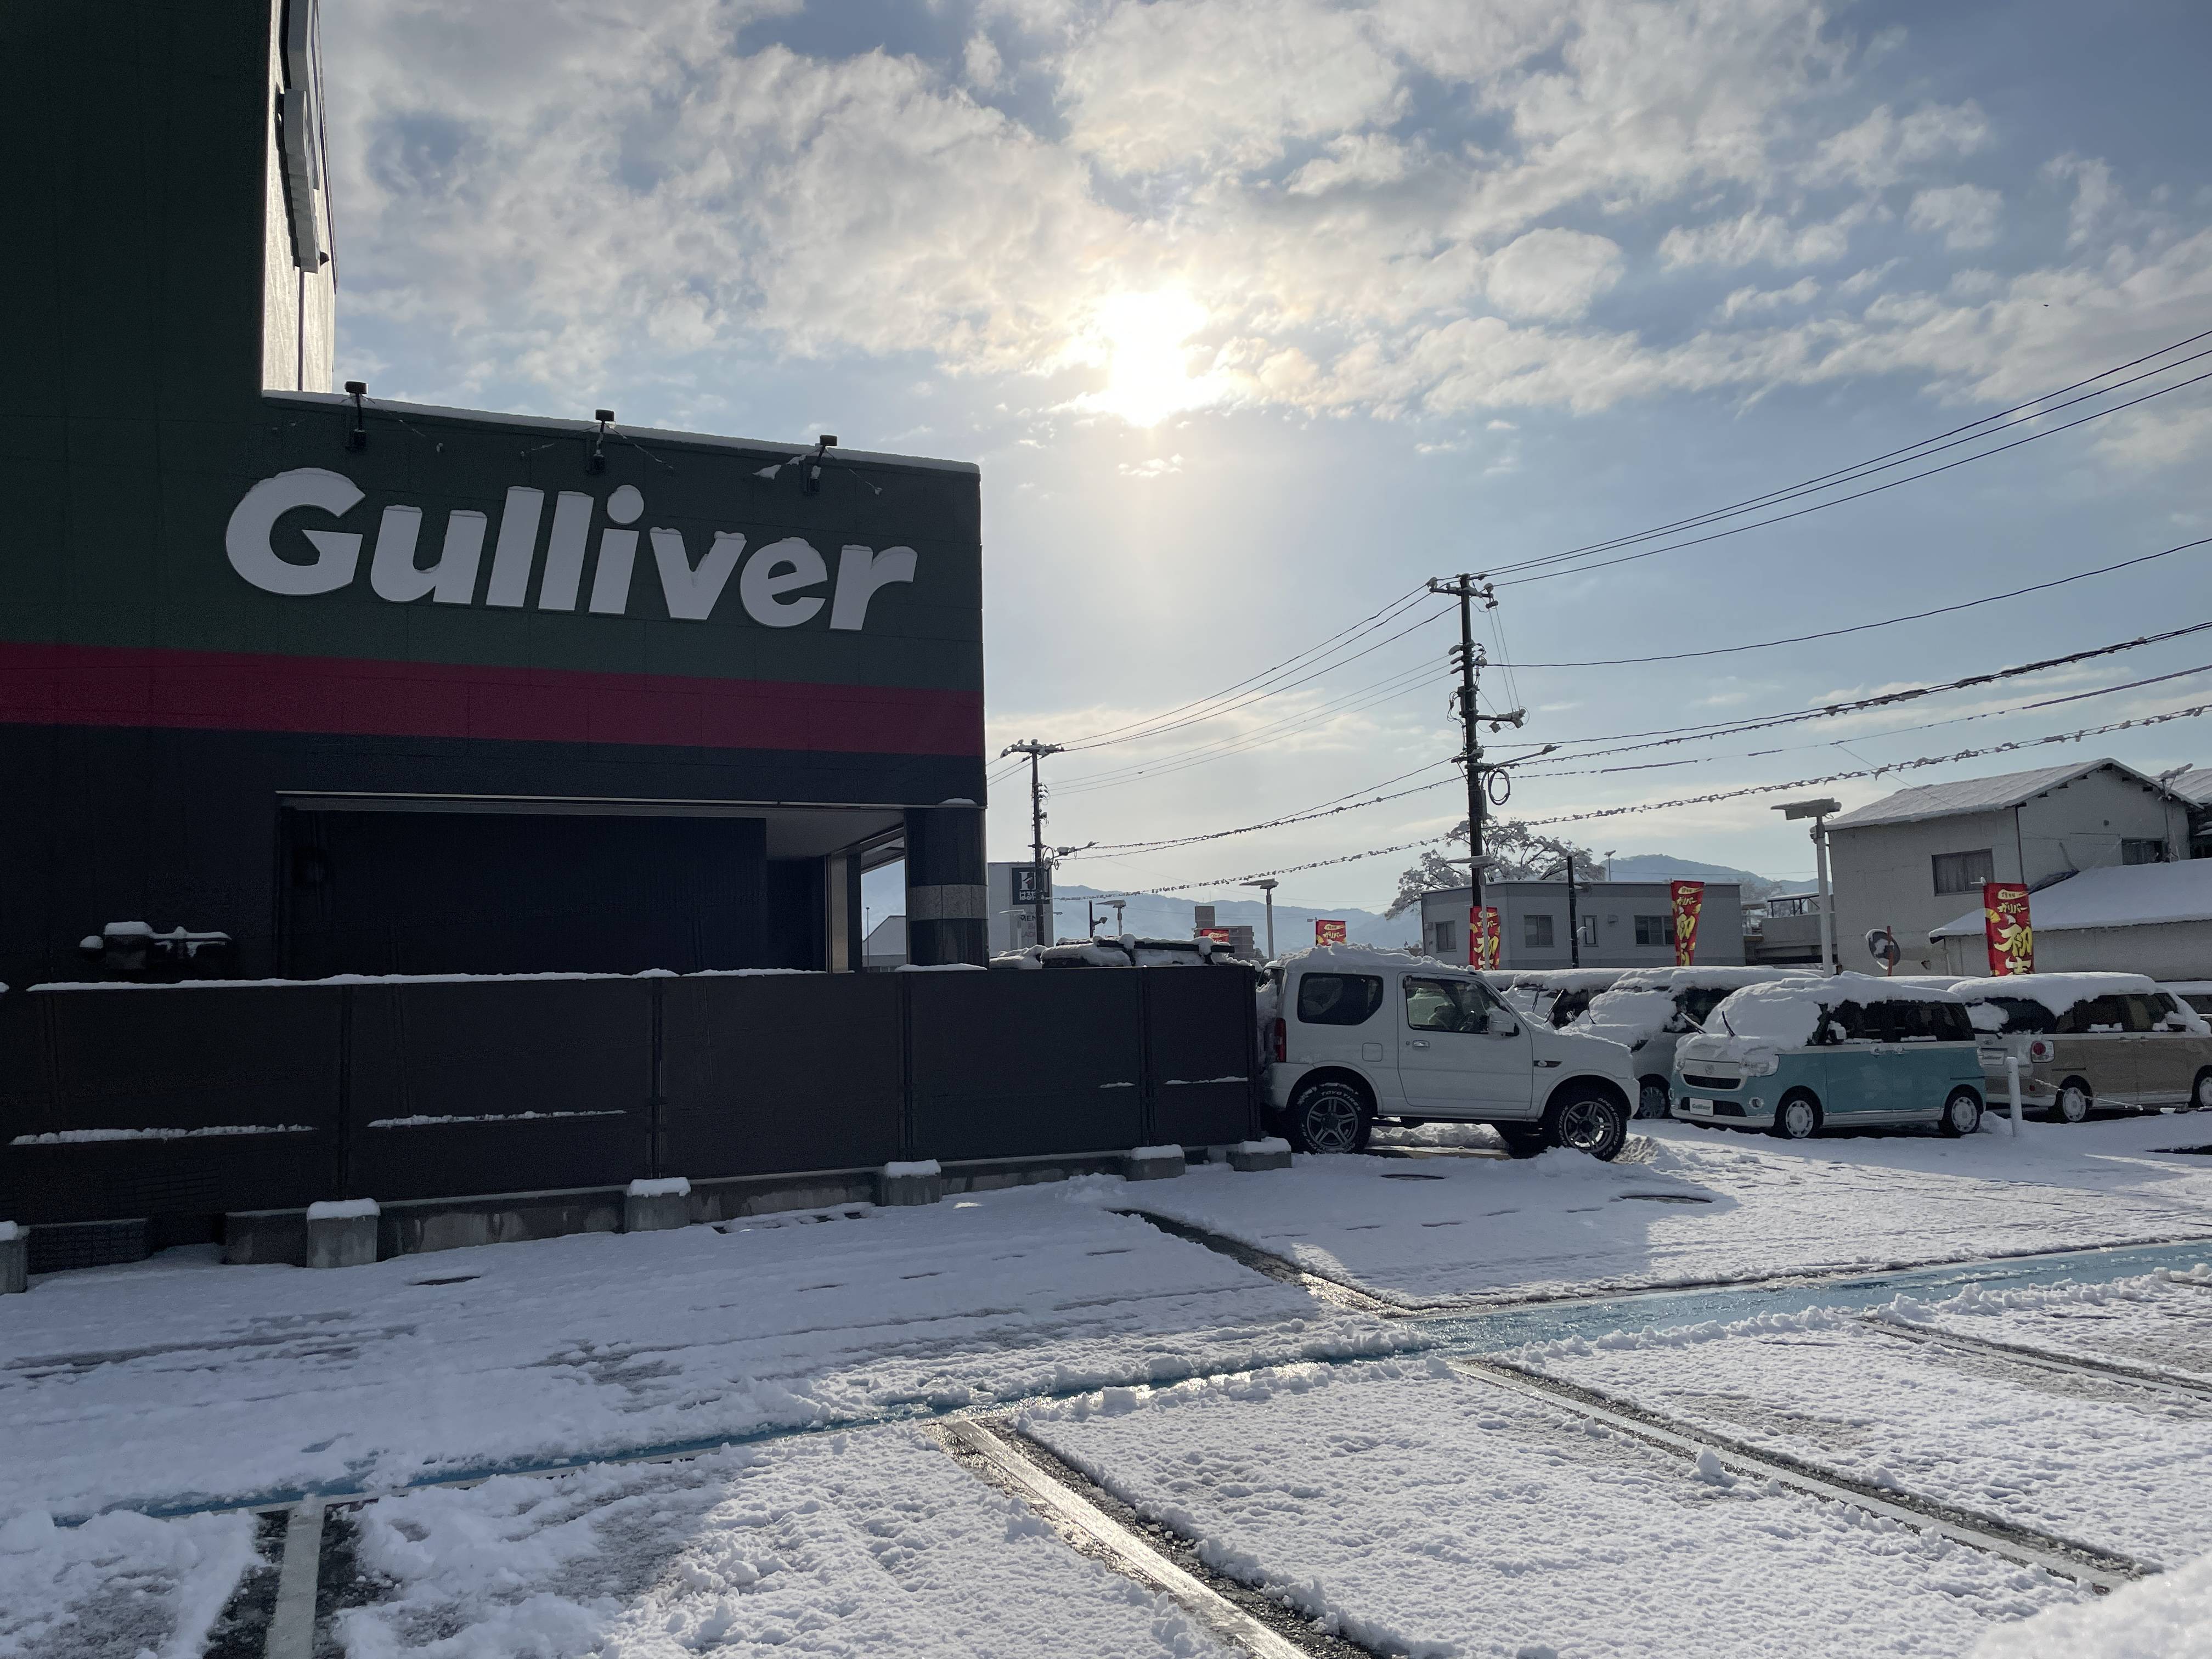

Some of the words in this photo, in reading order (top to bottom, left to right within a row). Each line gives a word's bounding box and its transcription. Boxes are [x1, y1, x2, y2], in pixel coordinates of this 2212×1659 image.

[225, 467, 918, 631] Gulliver
[1997, 902, 2028, 913] ガリバー
[1343, 1094, 1362, 1111] TIRES
